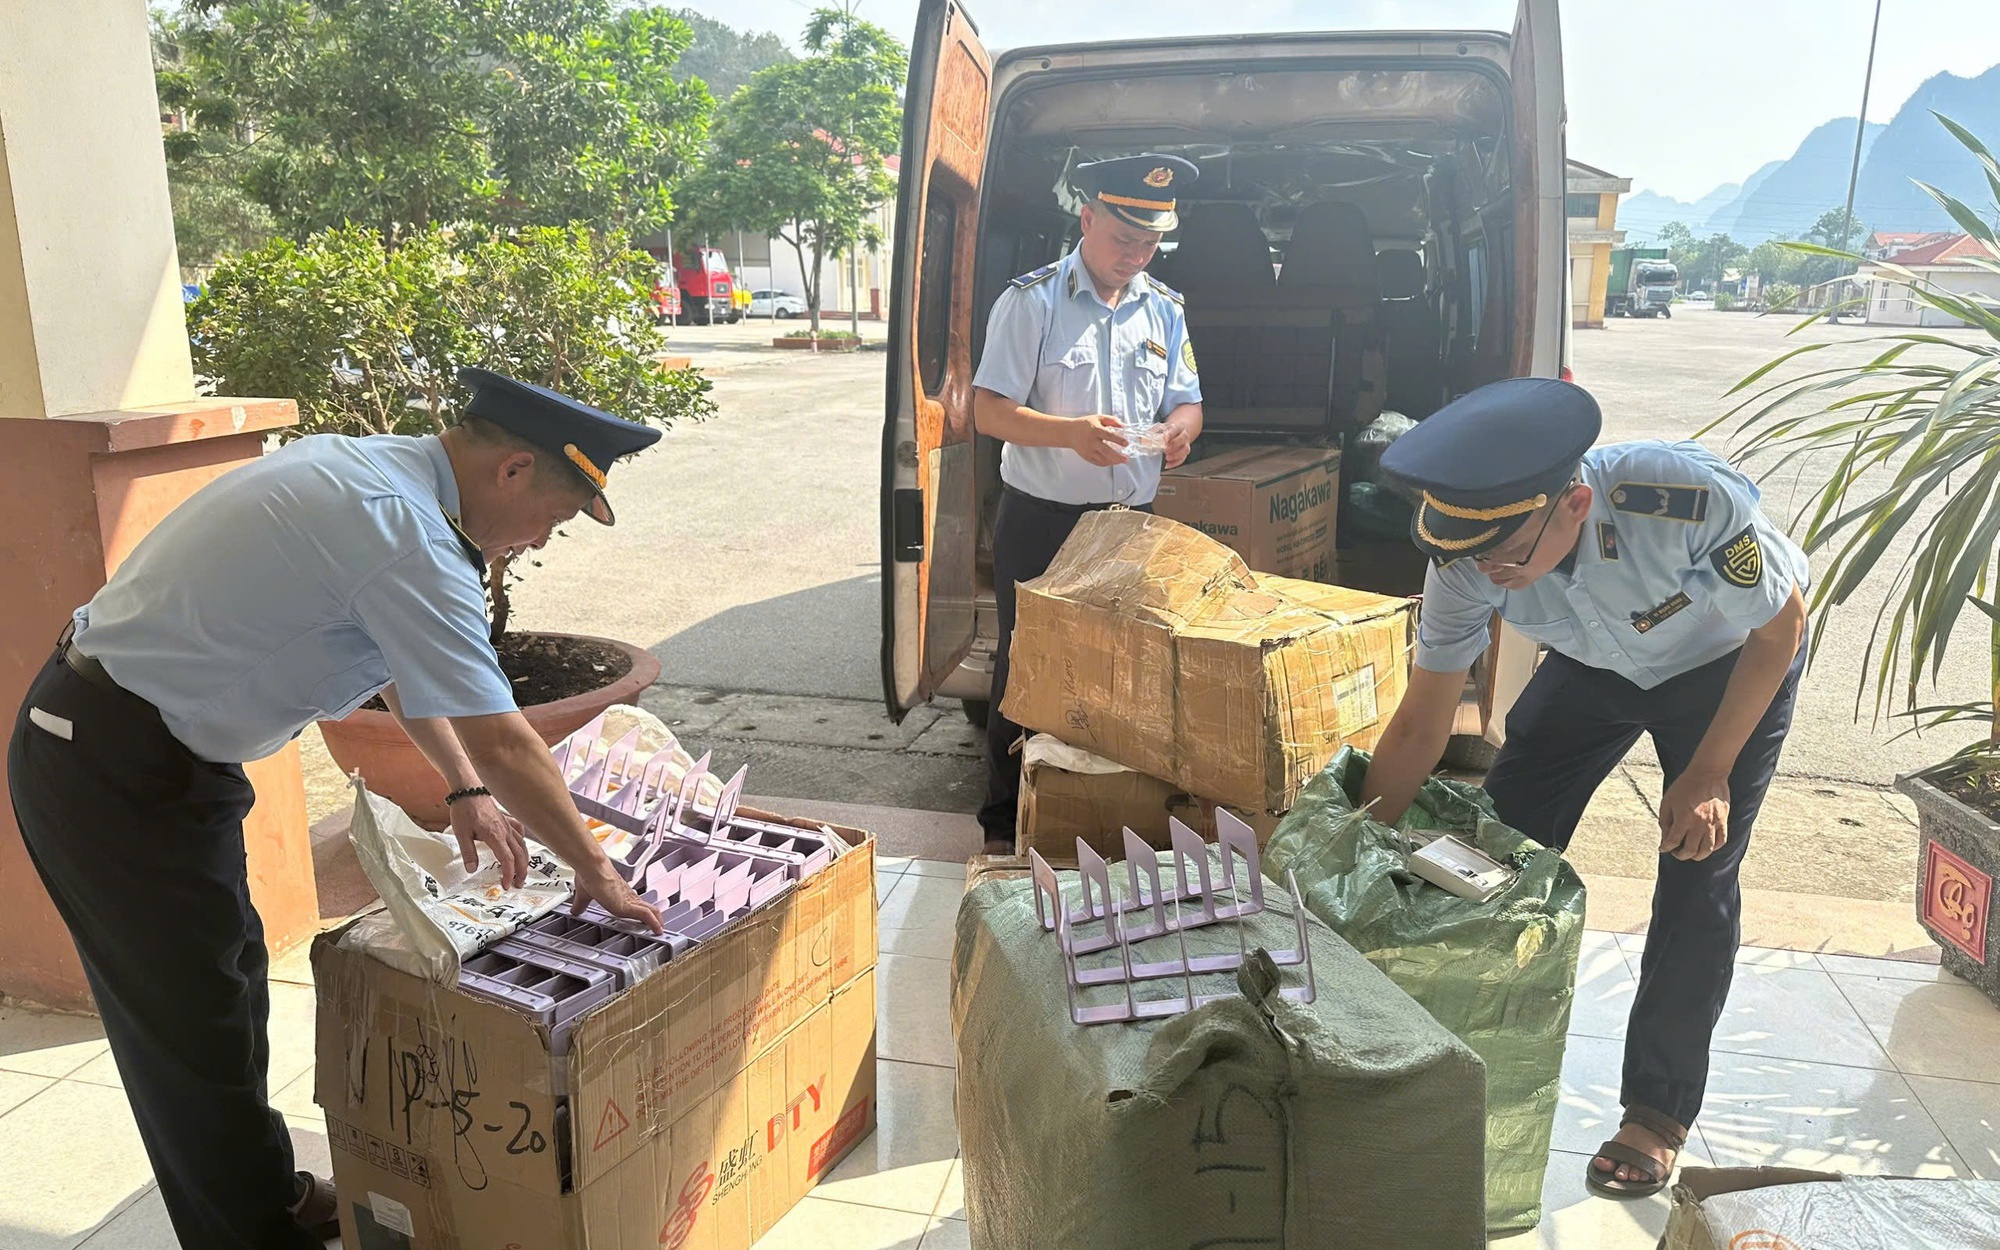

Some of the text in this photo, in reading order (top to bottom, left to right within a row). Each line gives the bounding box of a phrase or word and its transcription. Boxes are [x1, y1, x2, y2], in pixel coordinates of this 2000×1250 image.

[1269, 479, 1332, 524] Nagakawa
[1725, 534, 1751, 558] DMS
[665, 1032, 706, 1069] FOLLOWING
[710, 1021, 721, 1037] THE
[765, 979, 779, 997] DATE
[693, 1050, 701, 1063] TO
[704, 1040, 715, 1055] THE
[718, 1021, 741, 1045] PERIOD
[675, 1073, 688, 1090] THE
[691, 1045, 727, 1079] DIFFERENT
[729, 1035, 740, 1051] LOT
[767, 1072, 826, 1154] DTY
